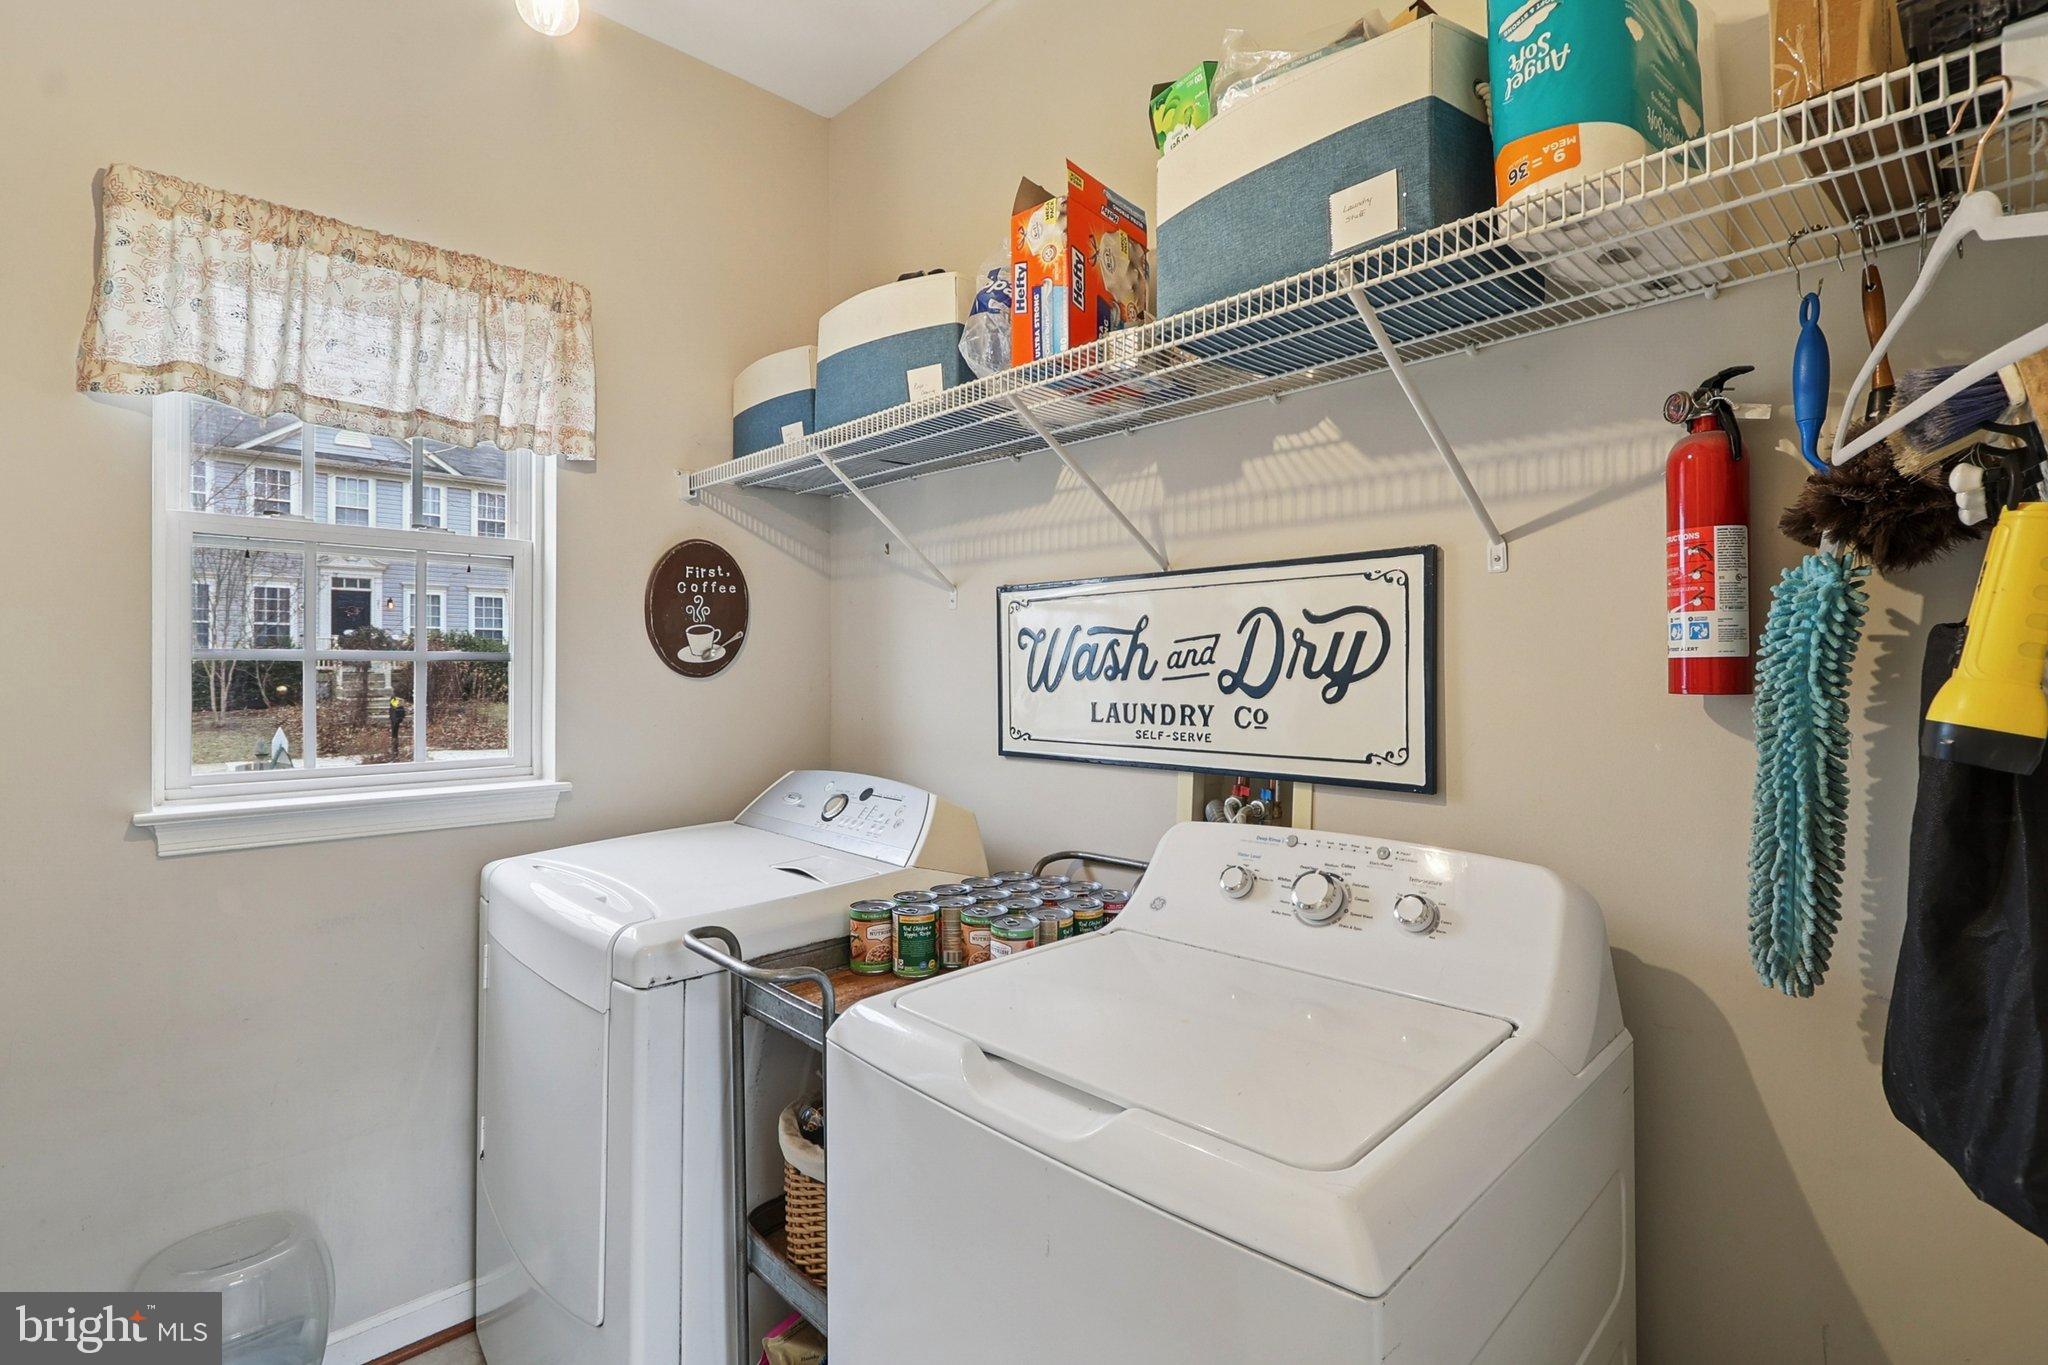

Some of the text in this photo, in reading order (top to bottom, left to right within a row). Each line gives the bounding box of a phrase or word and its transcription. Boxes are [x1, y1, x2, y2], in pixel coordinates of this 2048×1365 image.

[1508, 32, 1551, 72] Soft
[1505, 43, 1570, 101] Angel
[1542, 135, 1577, 154] MEGA
[1508, 162, 1529, 186] 36
[1016, 266, 1027, 311] Hefty
[1073, 253, 1084, 309] Hefty
[685, 565, 730, 578] First,
[677, 581, 737, 593] Coffee
[1018, 606, 1391, 704] Wash and Dry
[1091, 702, 1215, 727] LAUNDRY
[1135, 729, 1212, 743] SELF-SERVE
